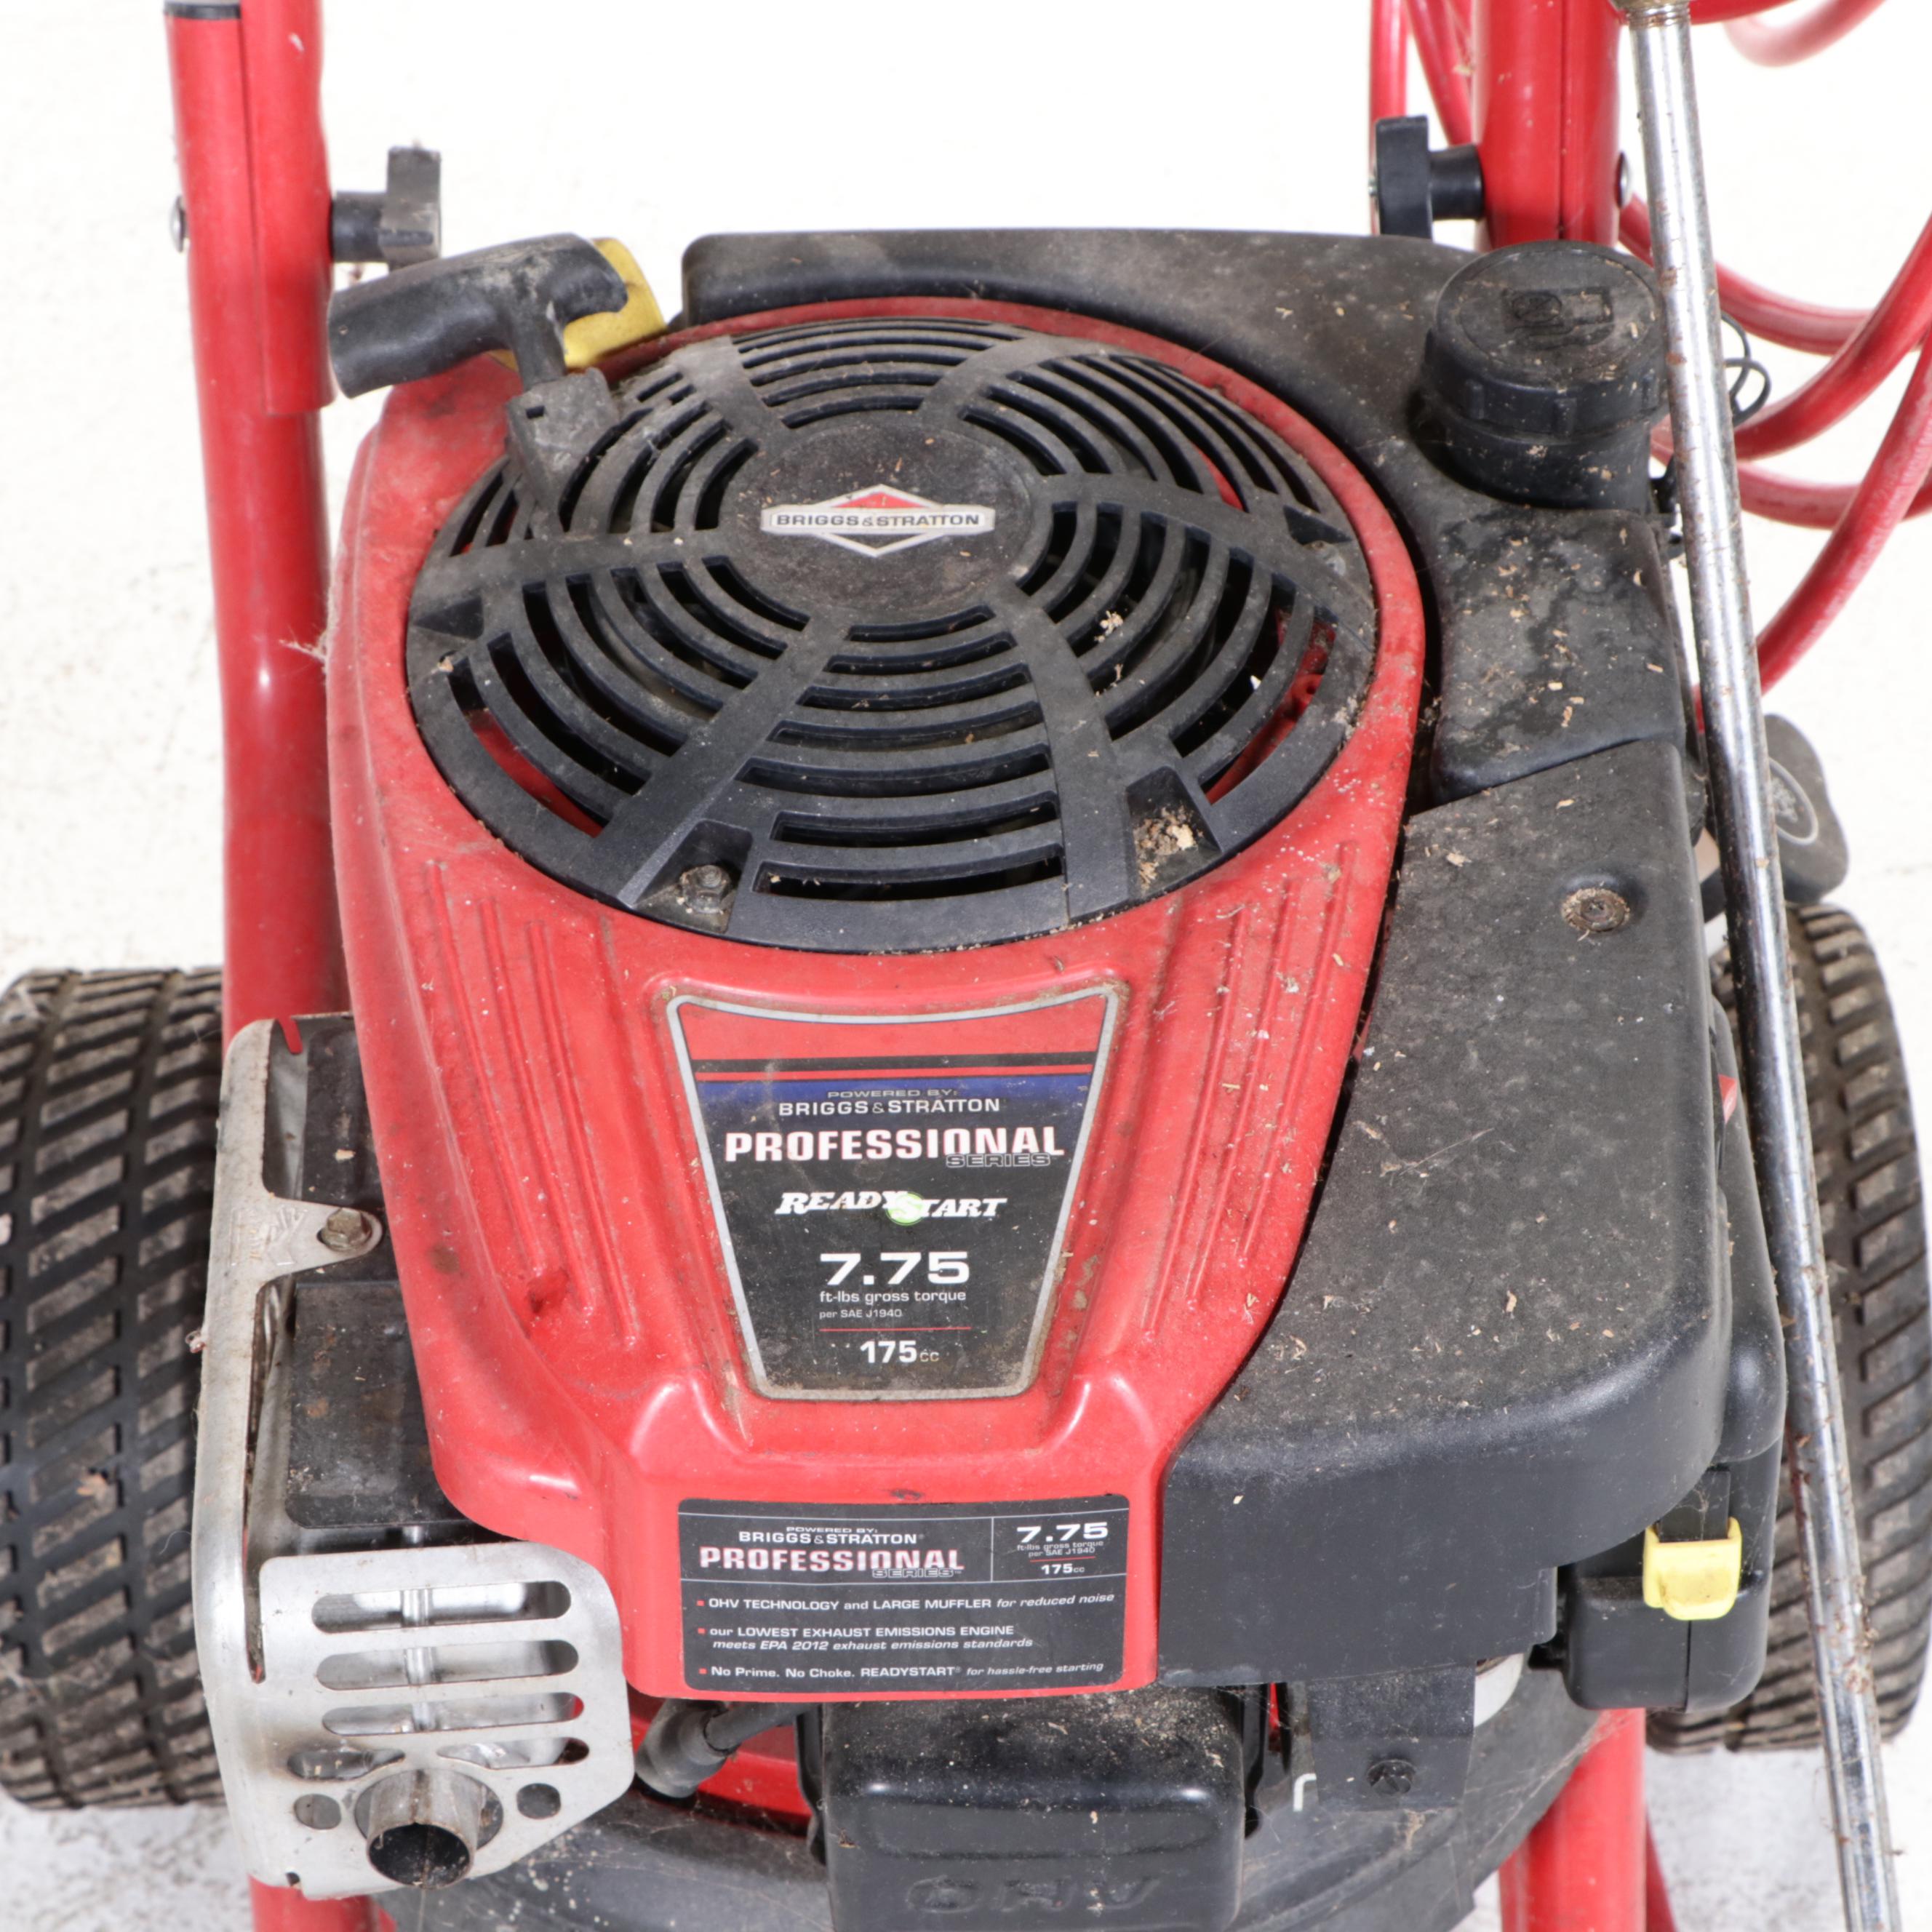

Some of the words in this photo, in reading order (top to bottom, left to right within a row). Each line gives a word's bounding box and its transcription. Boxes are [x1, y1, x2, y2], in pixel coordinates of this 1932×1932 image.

[725, 1126, 1065, 1162] PROFESSIONAL
[946, 1152, 1051, 1167] SERIES
[820, 1251, 970, 1285] 7.75
[819, 1290, 860, 1302] ft-lbs
[865, 1293, 909, 1305] gross
[914, 1290, 966, 1304] torque
[819, 1311, 837, 1319] per
[840, 1309, 863, 1317] SAE
[866, 1309, 902, 1317] J1940
[1016, 1522, 1109, 1543] 7.75
[699, 1546, 965, 1572] PROFESSIONAL
[708, 1598, 739, 1608] OHV
[743, 1600, 839, 1610] TECHNOLOGY
[844, 1600, 869, 1610] and
[873, 1600, 920, 1609] LARGE
[925, 1600, 991, 1609] MUFFLER
[997, 1599, 1015, 1608] for
[1020, 1595, 1074, 1607] reduced
[1079, 1593, 1114, 1603] noise
[738, 1627, 798, 1637] LOWEST
[803, 1628, 871, 1637] EXHAUST
[876, 1626, 955, 1637] EMISSIONS
[960, 1626, 1014, 1635] ENGINE
[713, 1641, 756, 1649] meets
[760, 1641, 787, 1650] EPA
[792, 1641, 829, 1650] 2012
[833, 1641, 886, 1650] exhaust
[891, 1640, 958, 1649] emissions
[963, 1638, 1033, 1648] standards
[711, 1666, 731, 1676] No
[735, 1667, 780, 1677] Prime.
[786, 1668, 805, 1677] No
[810, 1668, 855, 1677] Choke.
[967, 1667, 984, 1676] for
[987, 1666, 1053, 1675] hassle-free
[1055, 1663, 1103, 1672] starting
